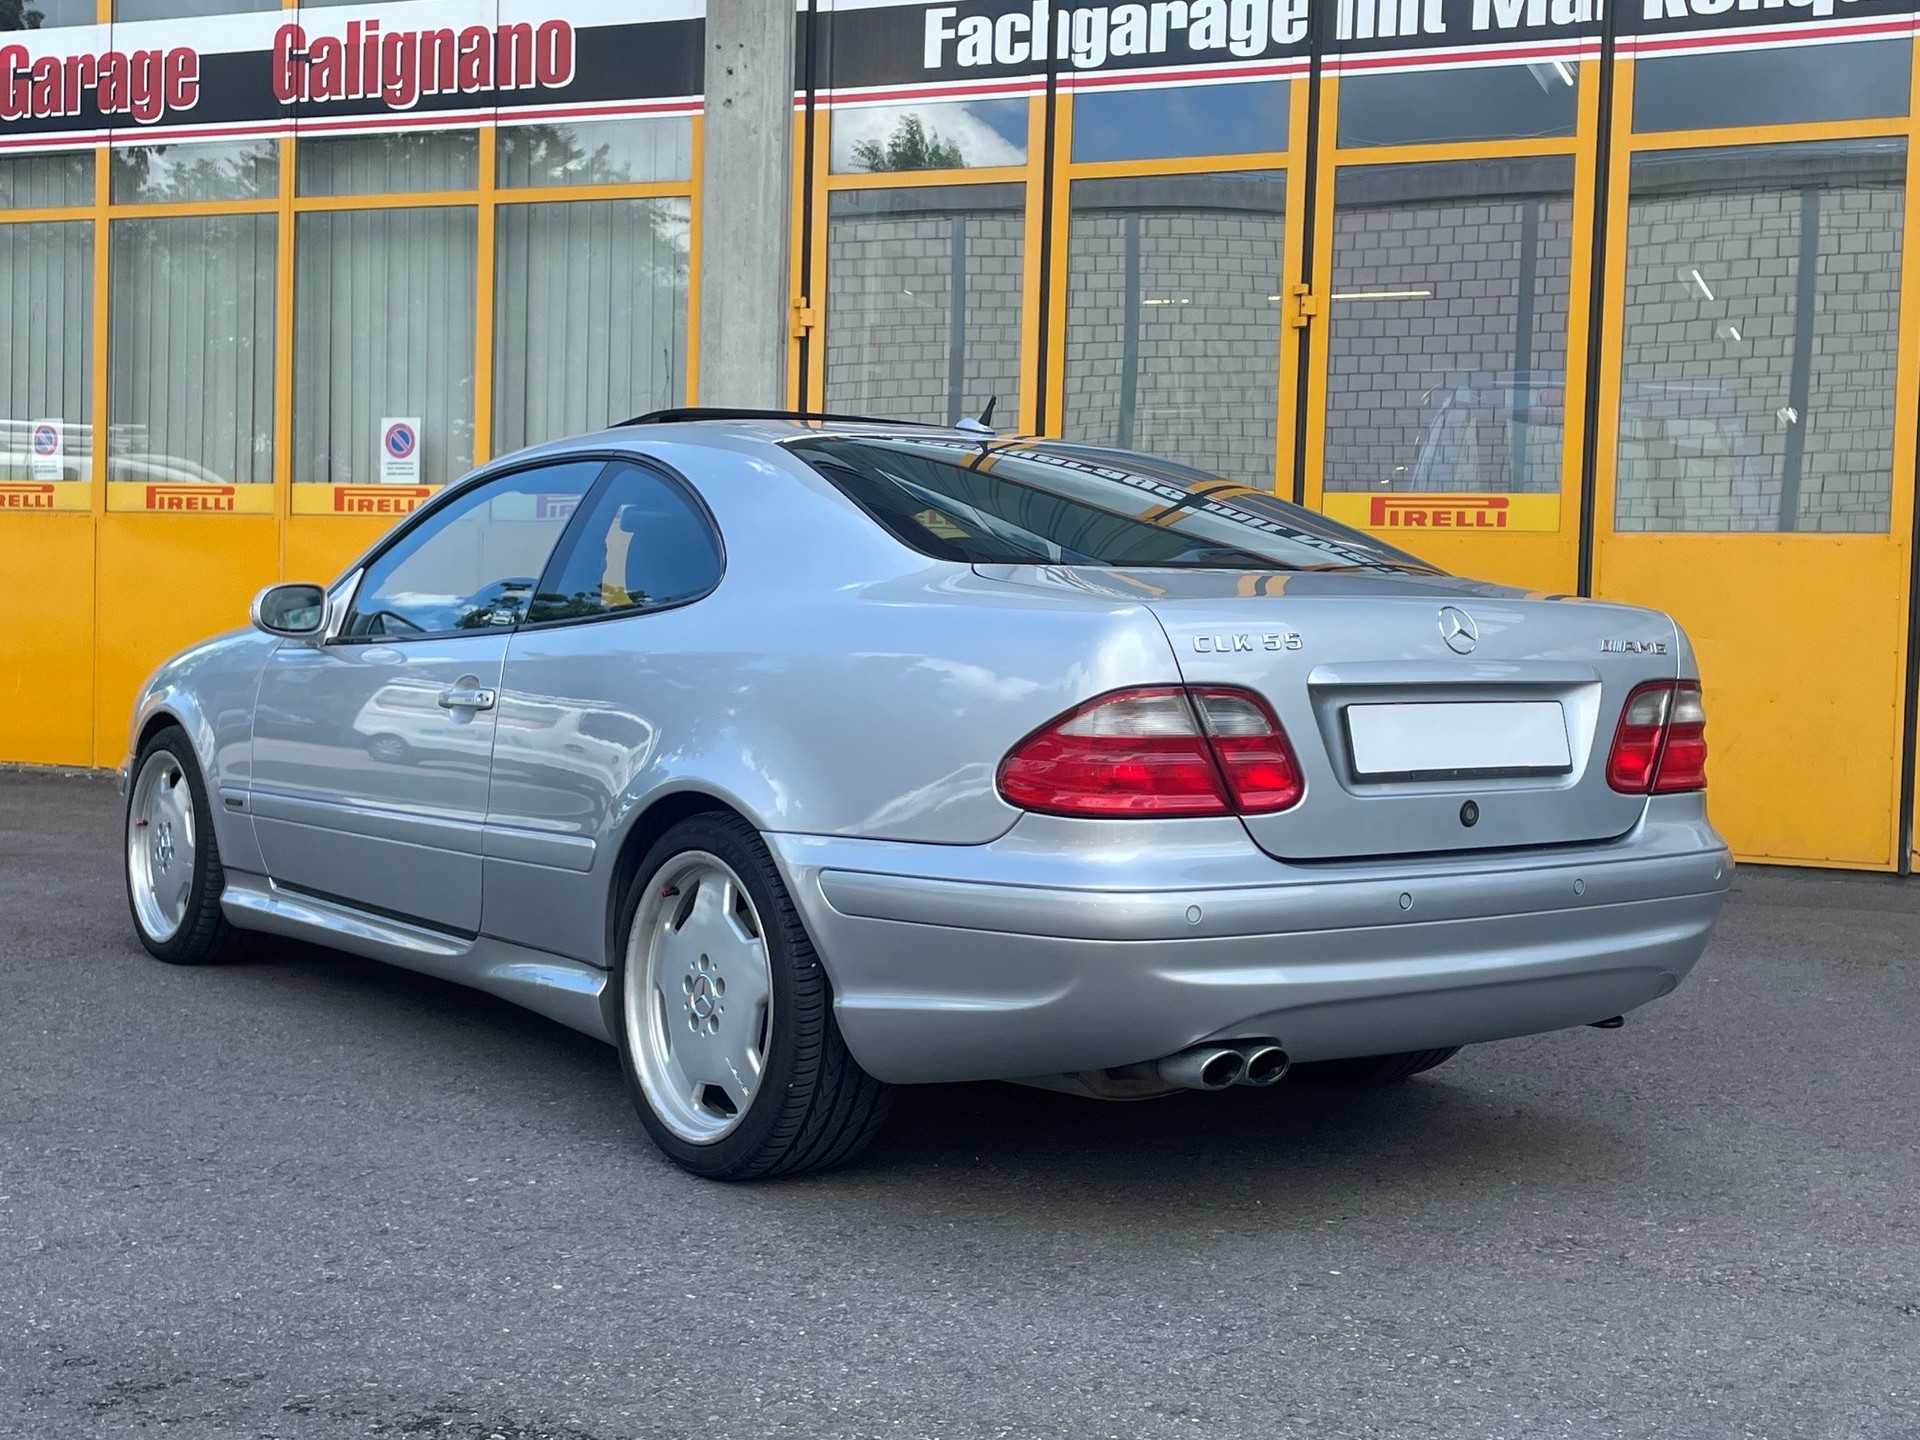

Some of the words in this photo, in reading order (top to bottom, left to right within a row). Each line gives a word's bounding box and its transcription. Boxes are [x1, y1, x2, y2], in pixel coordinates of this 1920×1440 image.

[924, 0, 1308, 69] Fachgarage
[0, 44, 200, 124] Garage
[272, 19, 576, 110] Galignano
[146, 486, 235, 510] PIRELLI
[334, 487, 430, 513] PIRELL
[1370, 497, 1510, 527] PIRELLI
[1193, 633, 1253, 653] CLK
[1262, 632, 1303, 651] 55
